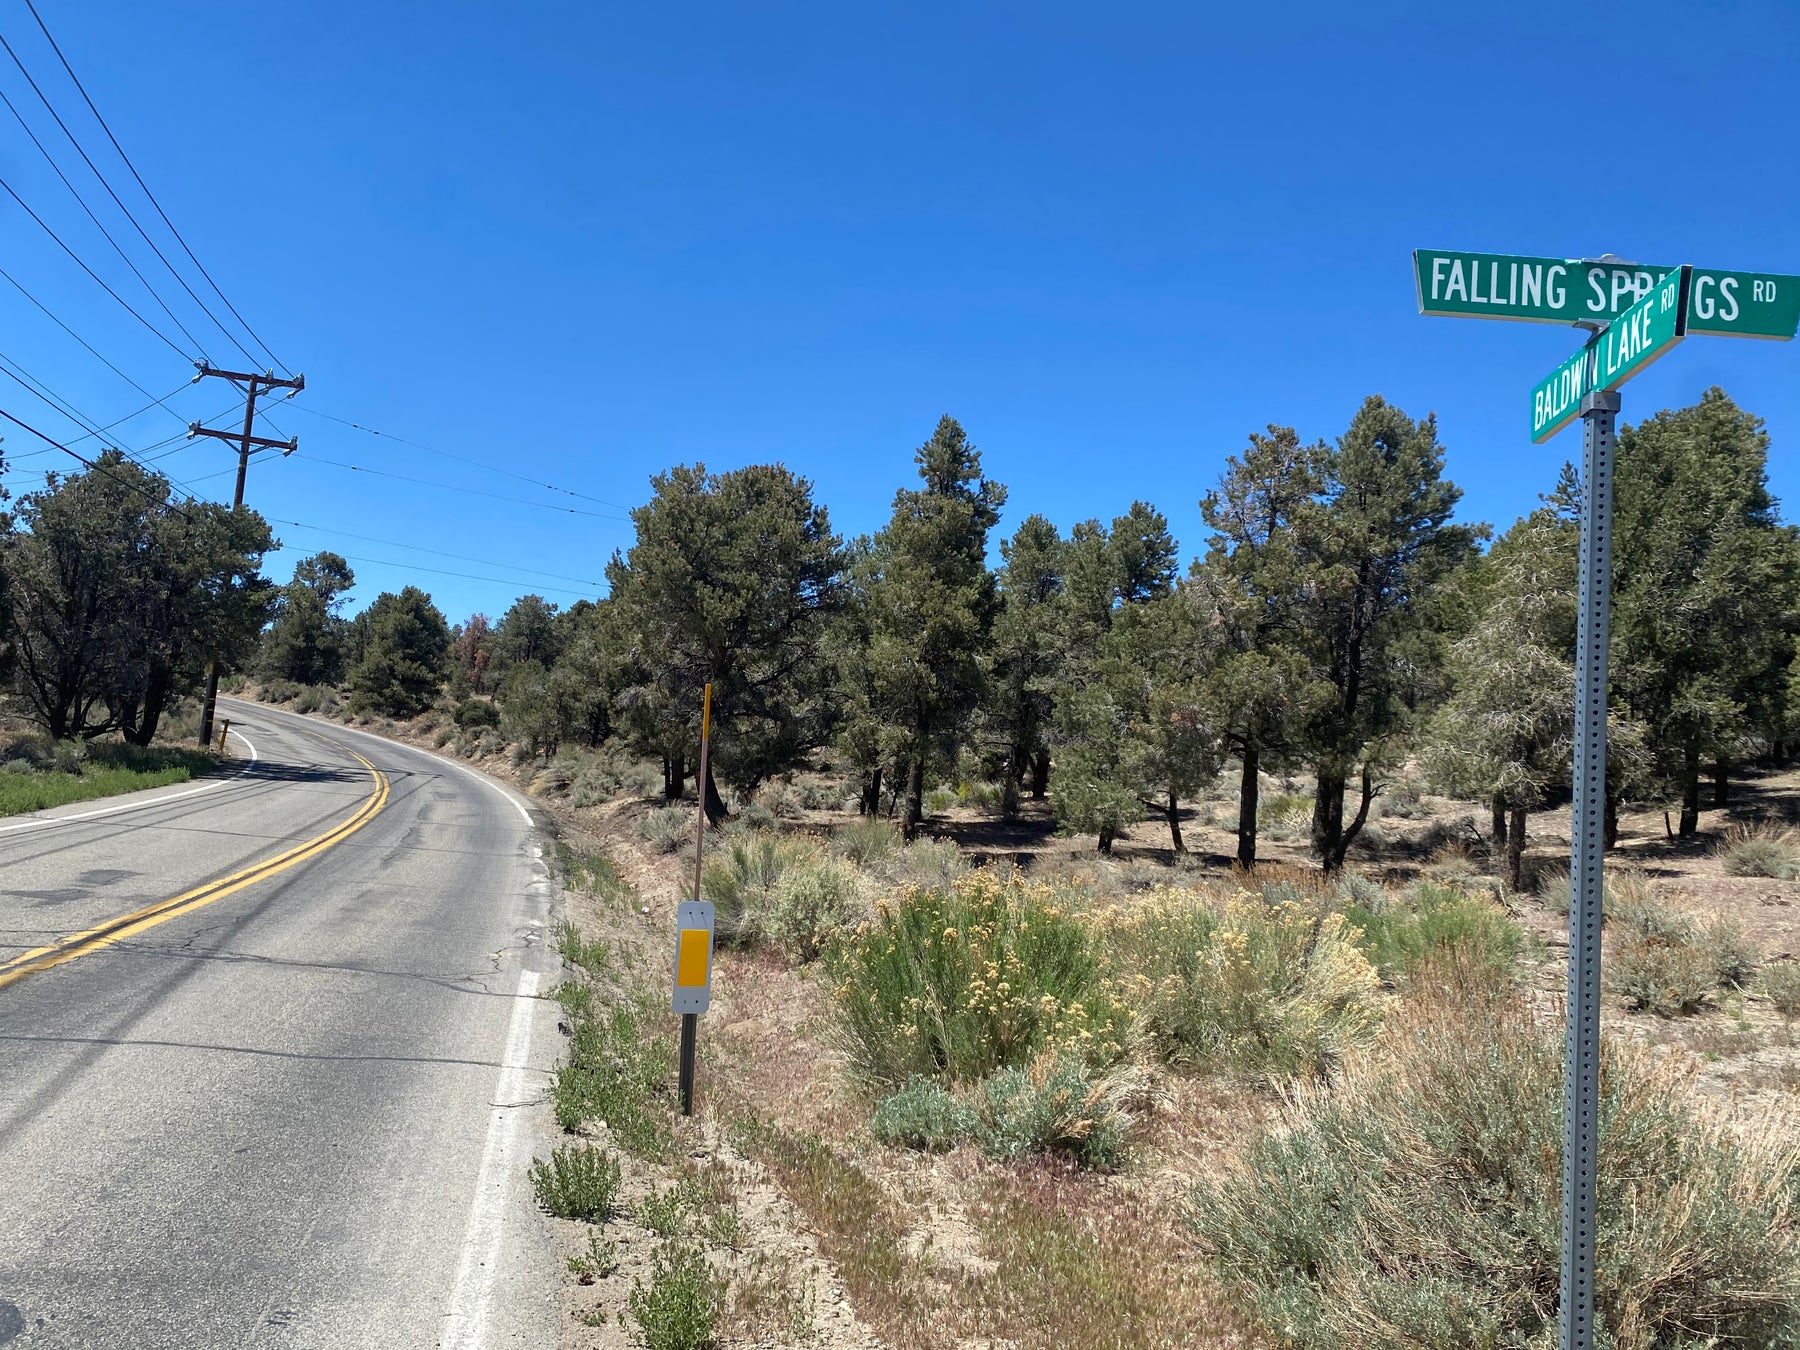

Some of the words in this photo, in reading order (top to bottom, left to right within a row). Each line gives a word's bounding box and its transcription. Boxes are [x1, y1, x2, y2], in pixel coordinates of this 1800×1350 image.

[1431, 257, 1567, 309] FALLING
[1586, 267, 1740, 322] SPRGS
[1752, 279, 1777, 303] RD
[1534, 344, 1599, 432] BALDWIN
[1607, 299, 1654, 376] LAKE
[1660, 283, 1675, 314] RD
